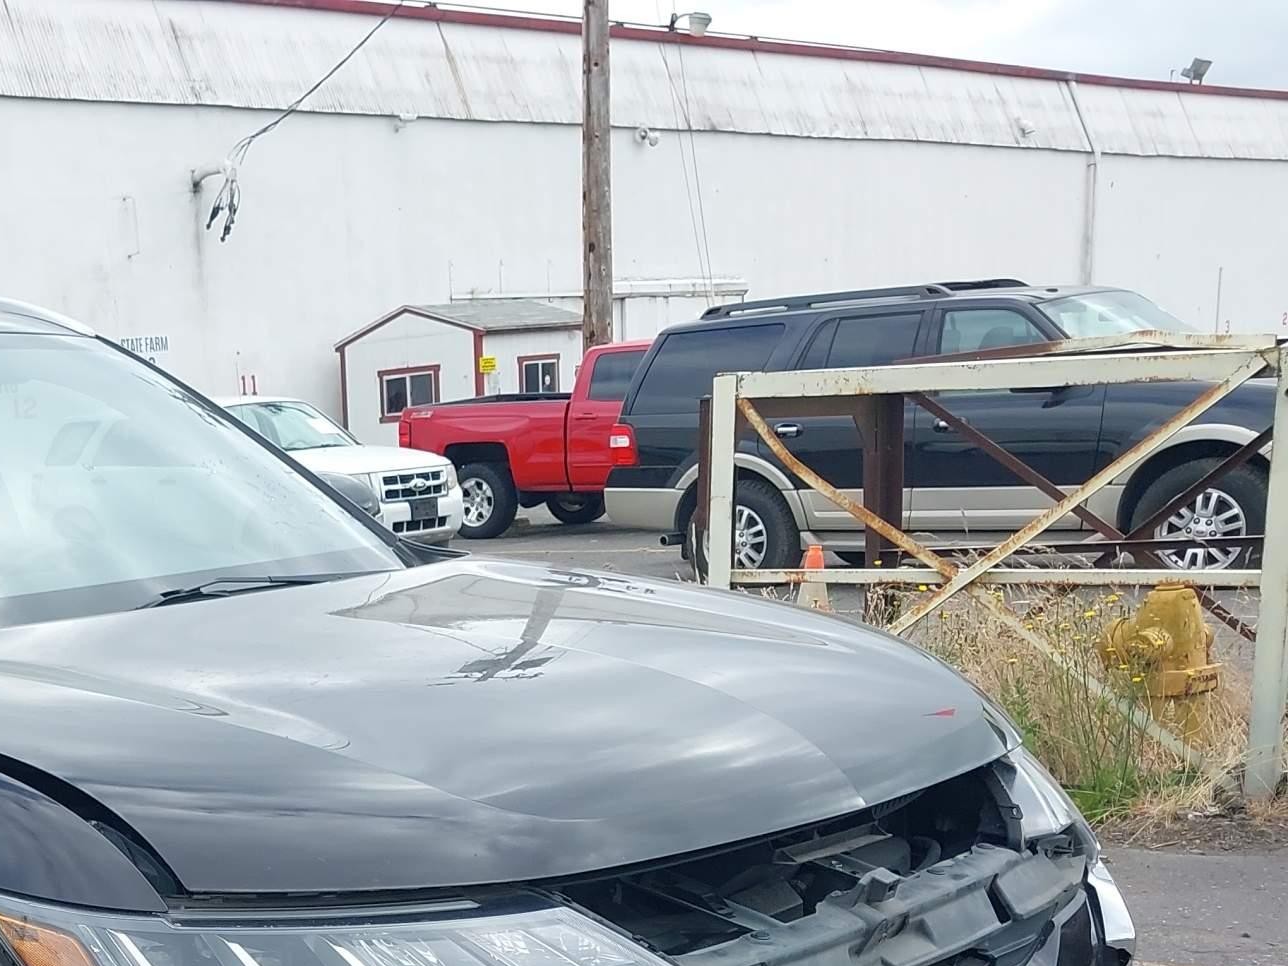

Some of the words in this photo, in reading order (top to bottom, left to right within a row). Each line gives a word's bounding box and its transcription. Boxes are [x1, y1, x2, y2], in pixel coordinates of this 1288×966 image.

[120, 338, 143, 353] STATE
[144, 336, 168, 353] FARM
[241, 375, 258, 396] 11
